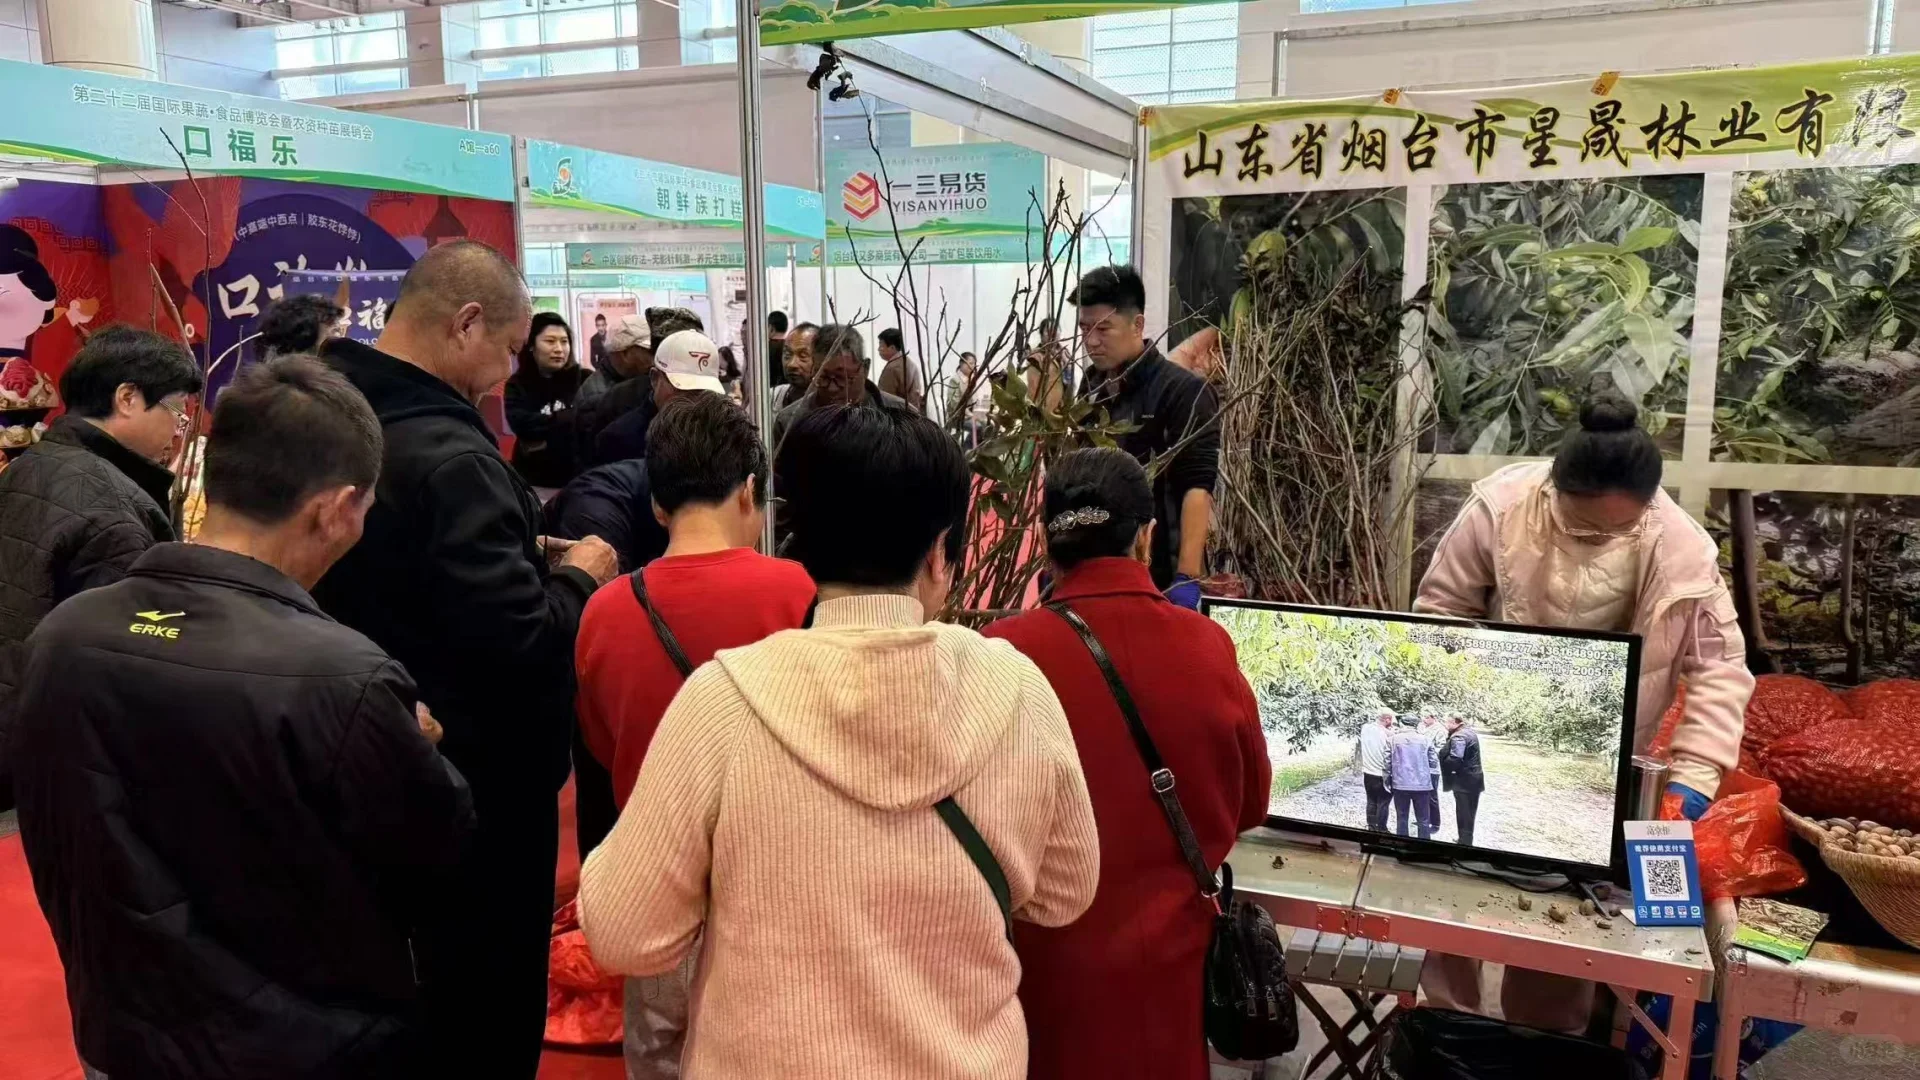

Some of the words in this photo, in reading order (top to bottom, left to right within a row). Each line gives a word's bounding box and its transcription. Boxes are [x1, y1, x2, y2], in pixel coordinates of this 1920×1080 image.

[73, 84, 374, 141] 第二十二届国际果蔬·食品博览会暨农资种苗展销会
[183, 124, 298, 166] 口福乐
[891, 171, 986, 195] 一三易货
[892, 197, 987, 213] YISANYIHUO
[129, 623, 181, 639] ERKE
